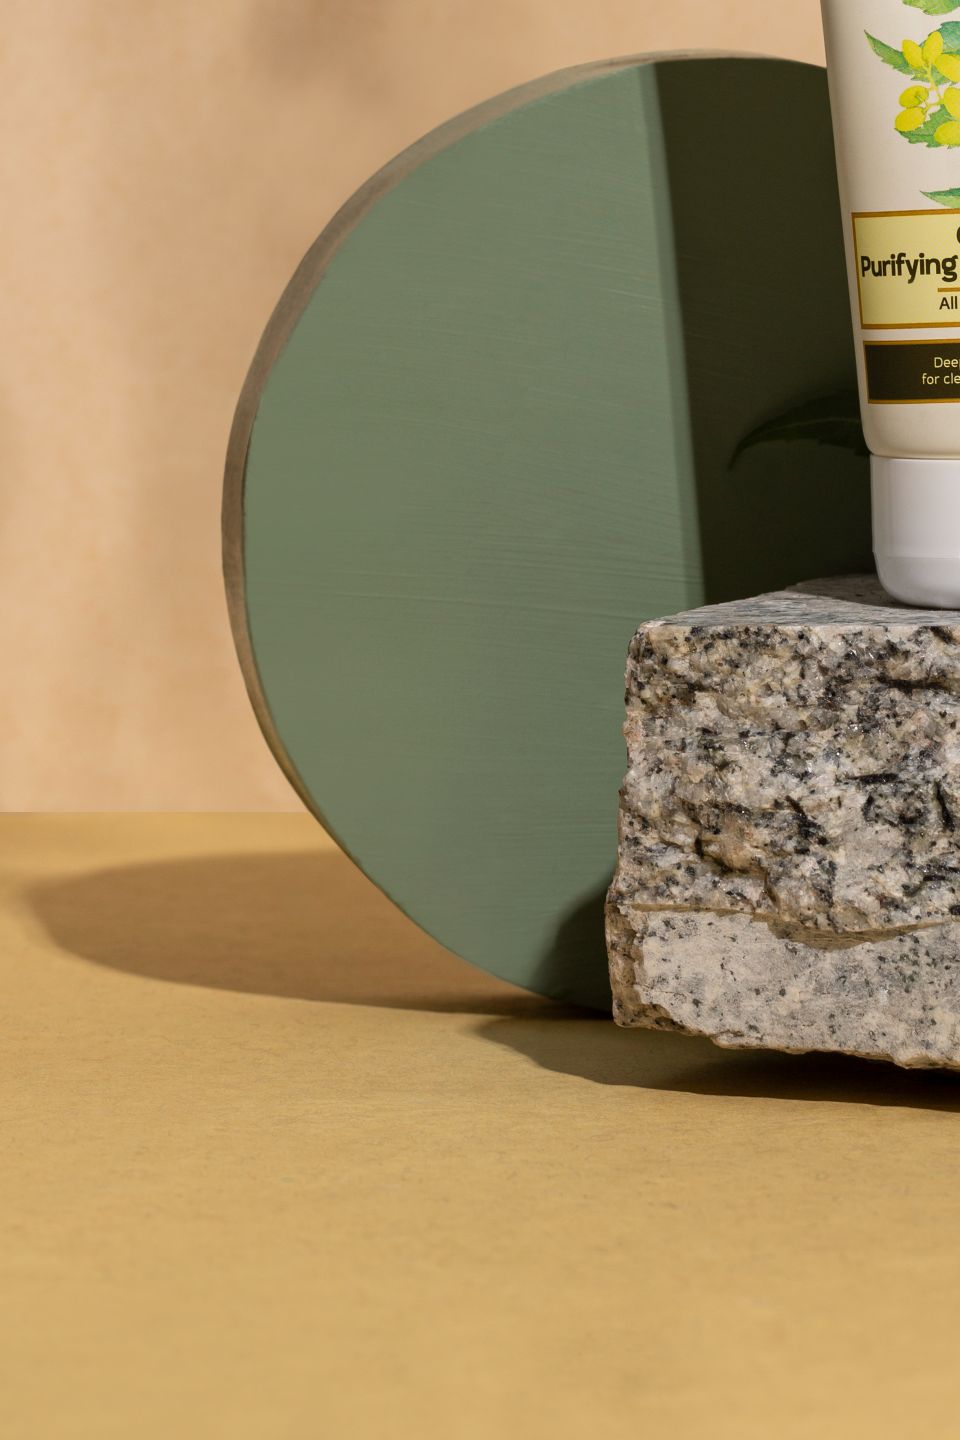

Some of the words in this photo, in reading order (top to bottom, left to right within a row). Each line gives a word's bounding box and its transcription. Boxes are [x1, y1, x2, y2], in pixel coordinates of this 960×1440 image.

[861, 253, 958, 284] Purifying
[940, 296, 958, 310] All
[921, 373, 939, 385] for
